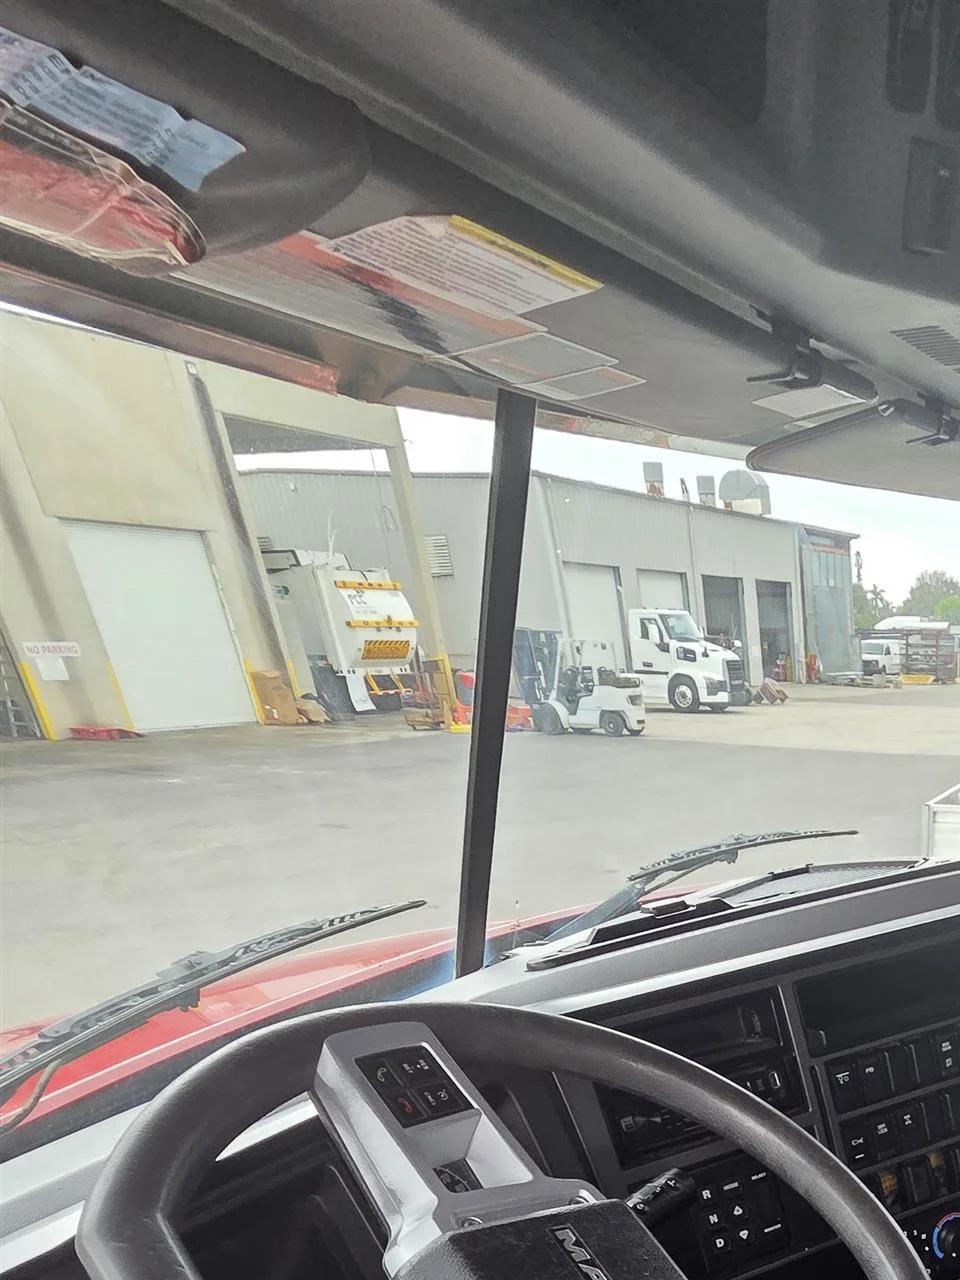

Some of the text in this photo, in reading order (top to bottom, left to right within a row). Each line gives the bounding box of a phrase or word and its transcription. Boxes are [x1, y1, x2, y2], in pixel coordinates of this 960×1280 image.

[25, 645, 78, 655] NO PARKING
[702, 1189, 712, 1200] R
[709, 1213, 719, 1224] N
[716, 1238, 725, 1248] D
